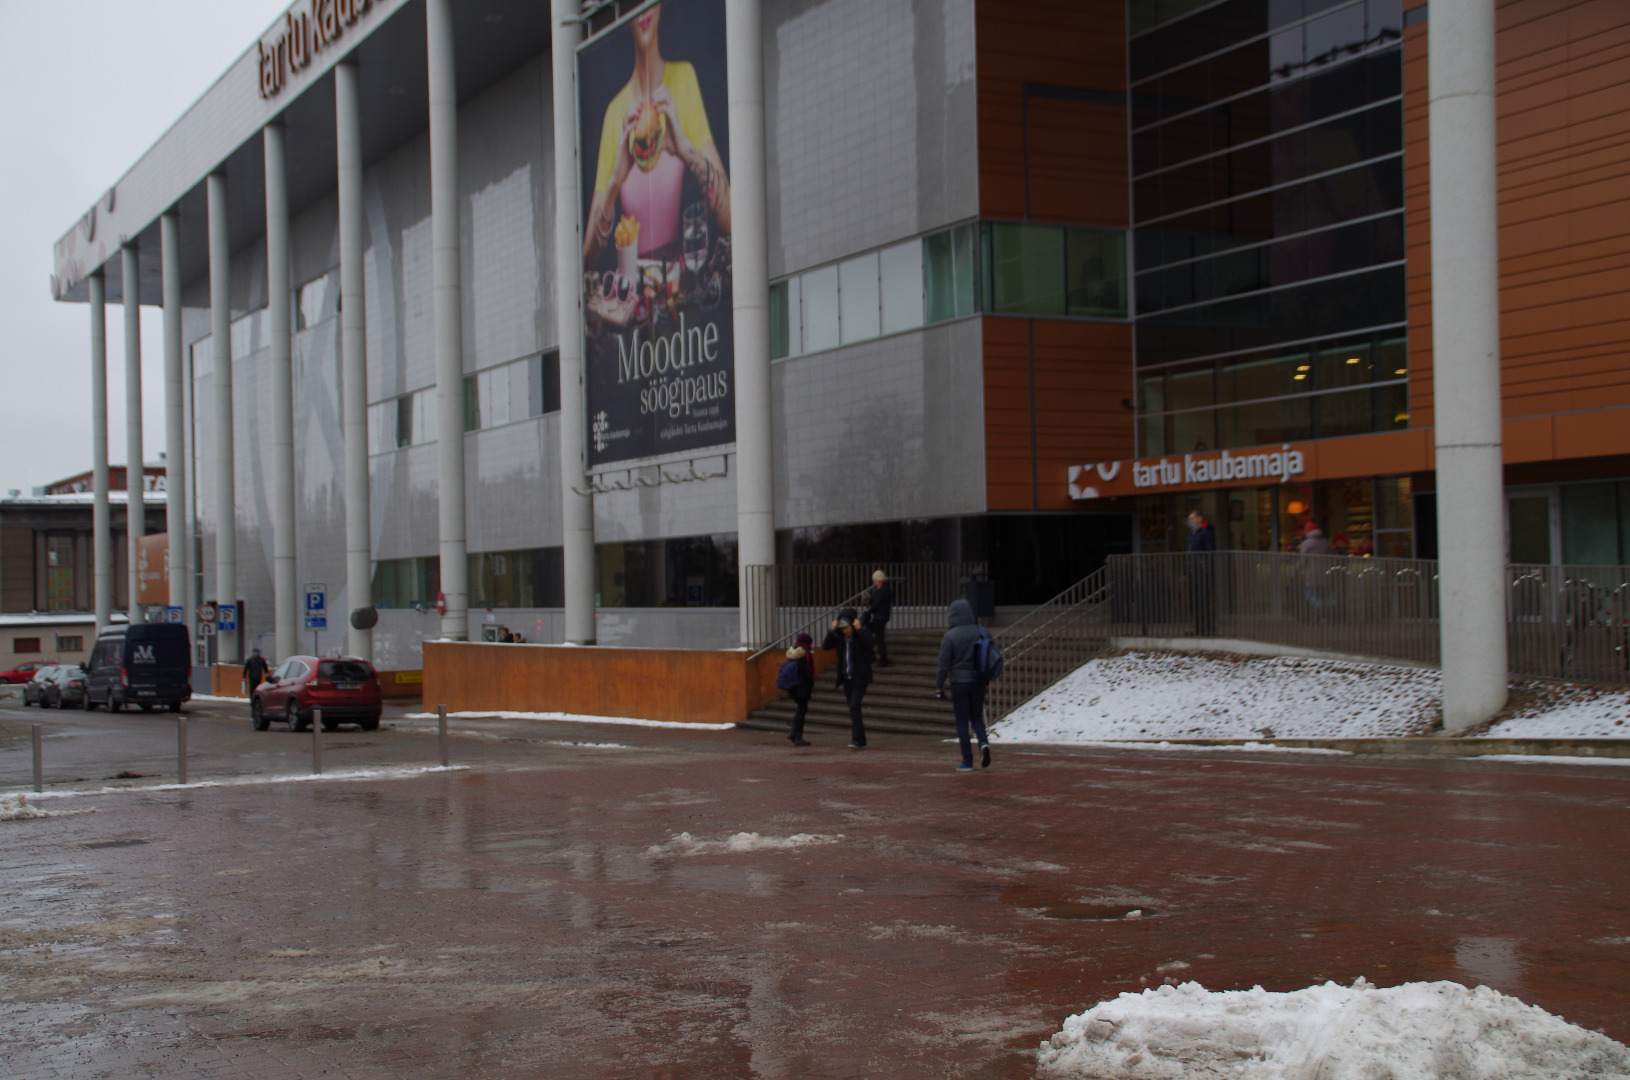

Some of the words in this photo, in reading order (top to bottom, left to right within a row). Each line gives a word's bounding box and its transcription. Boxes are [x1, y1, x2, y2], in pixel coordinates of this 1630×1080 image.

[258, 11, 312, 99] tartu
[617, 311, 719, 384] Moodne
[640, 370, 728, 419] söögipaus
[1132, 458, 1182, 488] tartu
[1184, 444, 1304, 484] kaubamaja
[310, 593, 321, 608] P
